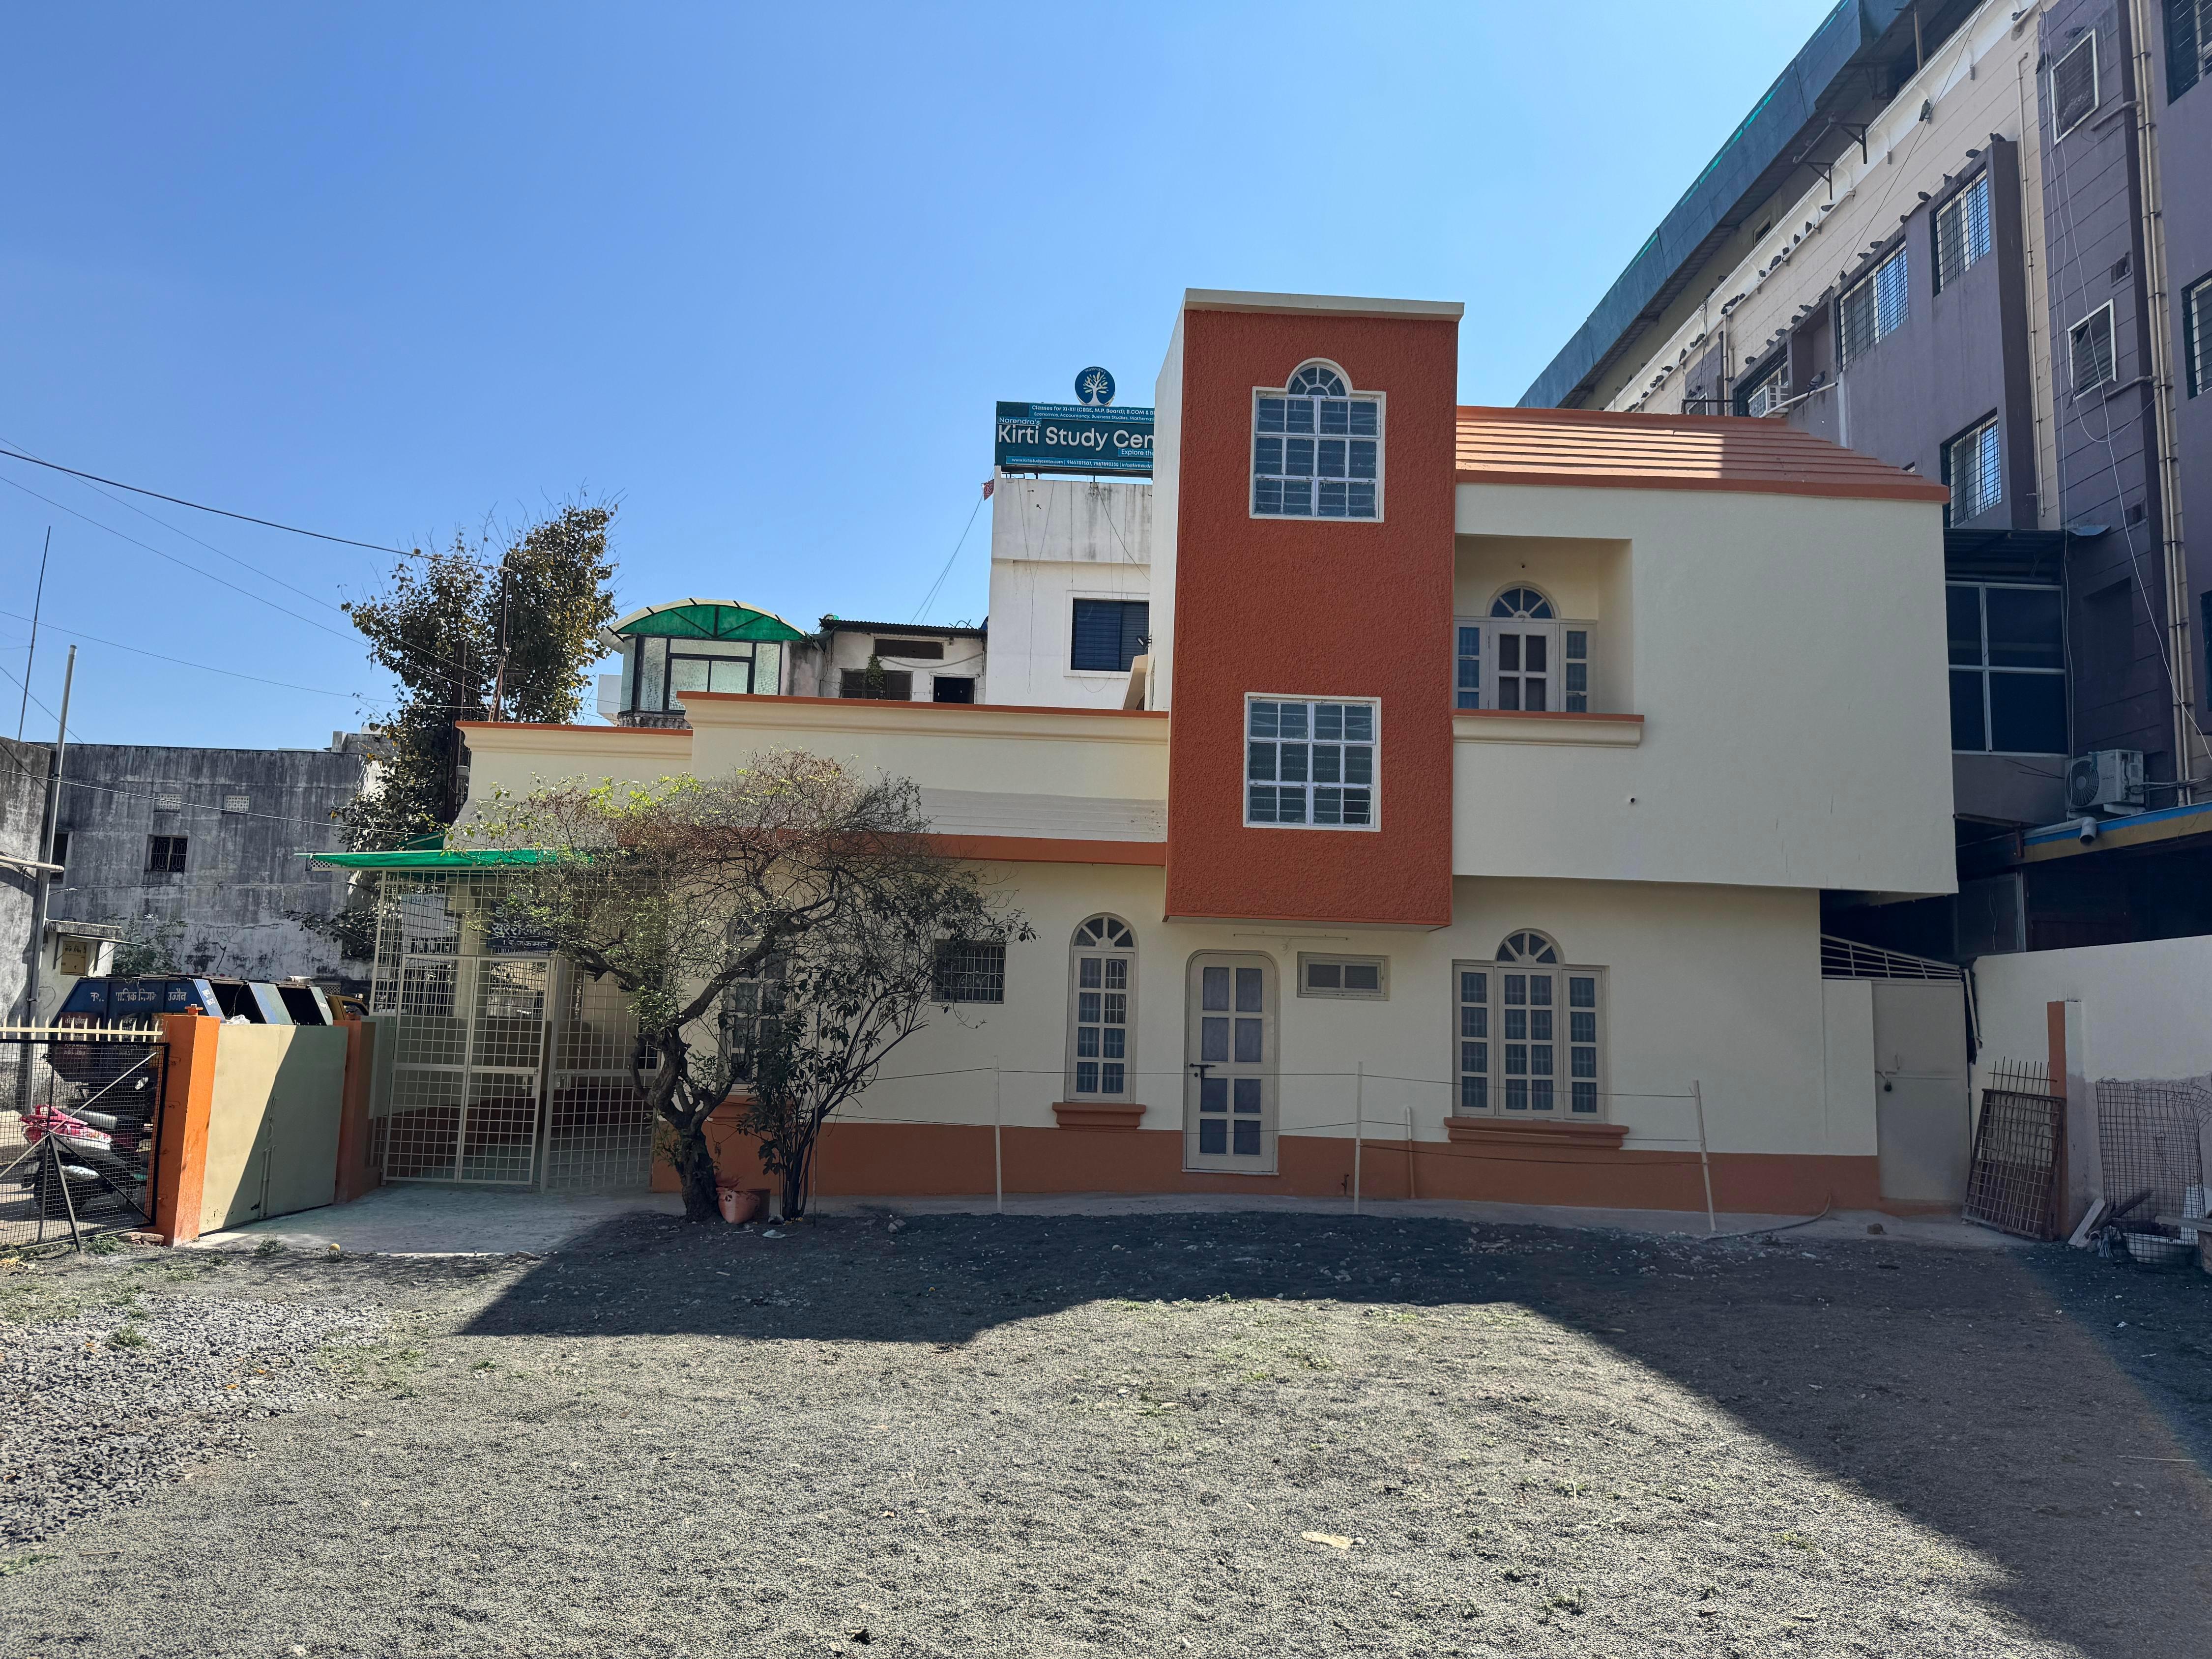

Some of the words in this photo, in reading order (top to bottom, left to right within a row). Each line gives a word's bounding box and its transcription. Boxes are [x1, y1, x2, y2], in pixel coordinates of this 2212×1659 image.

[998, 425, 1039, 445] Kirti
[1046, 427, 1108, 452] Study
[1113, 430, 1154, 449] Cen
